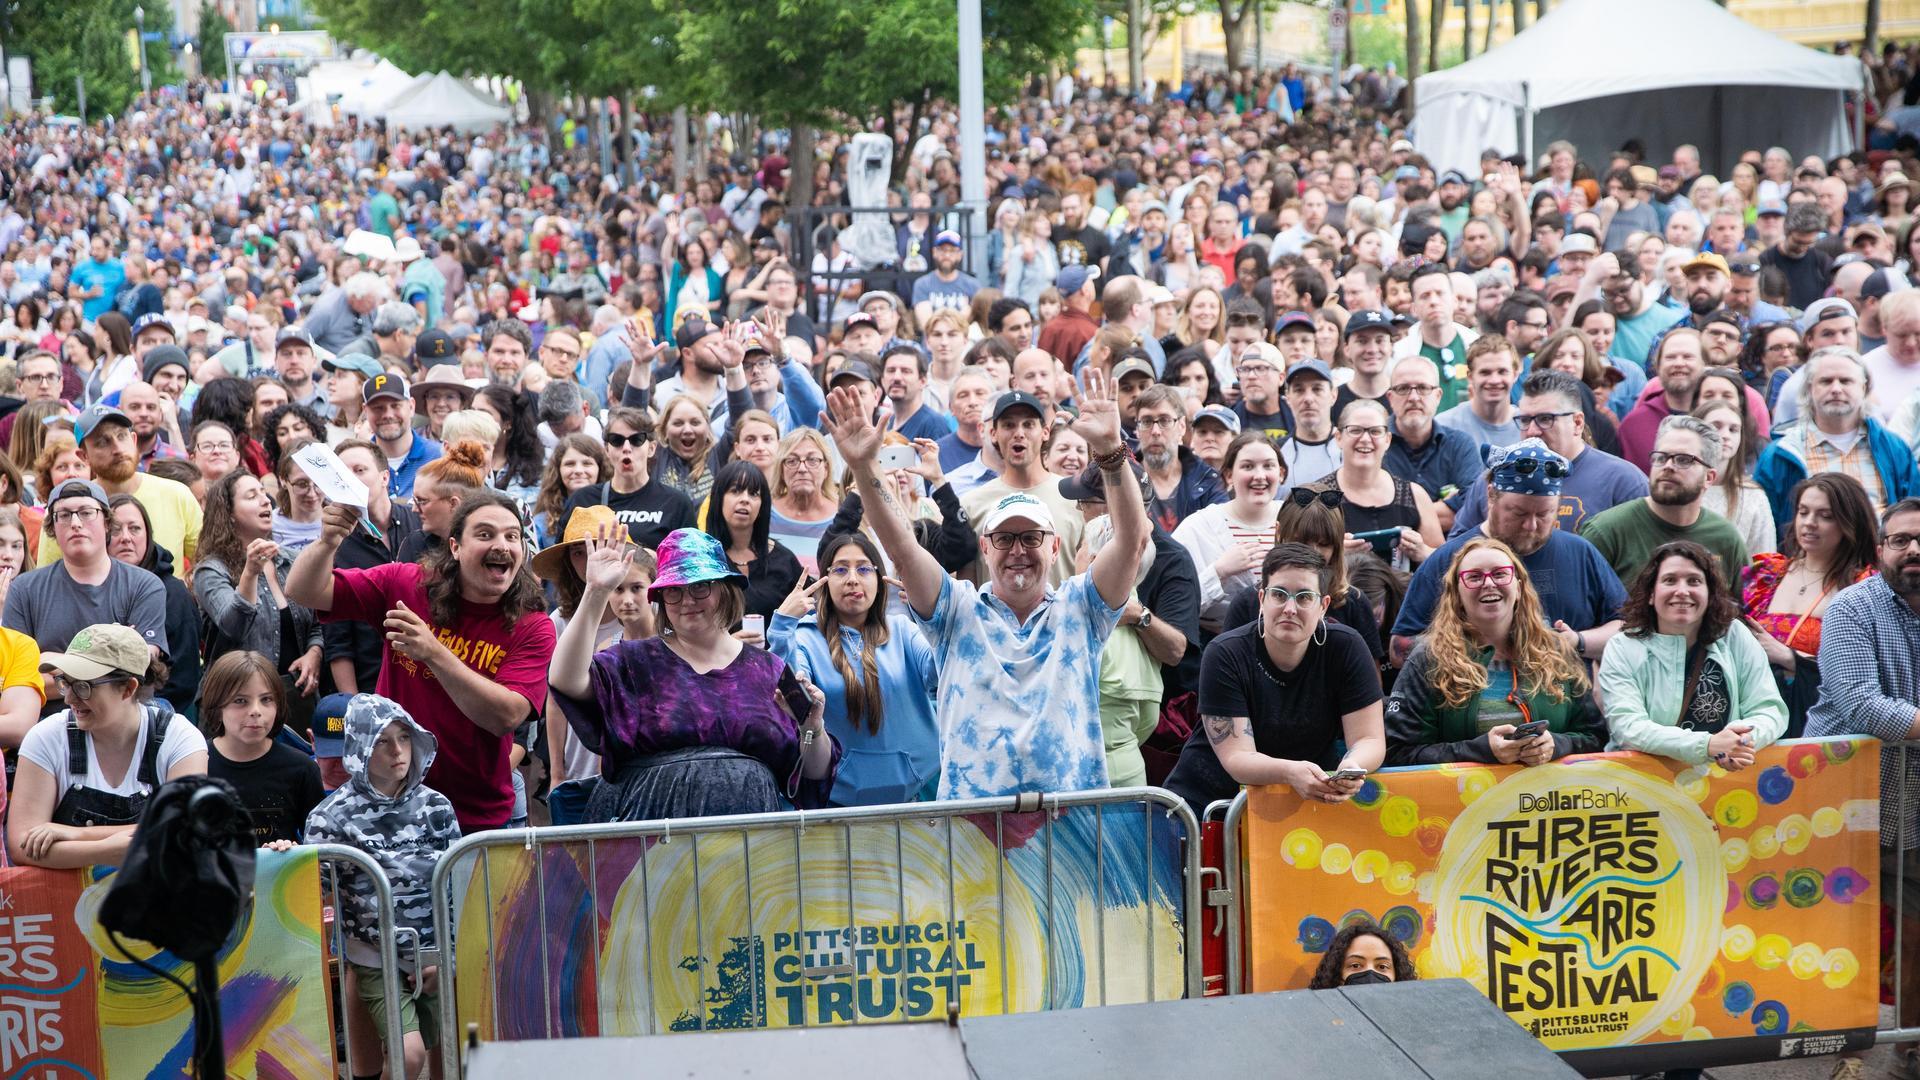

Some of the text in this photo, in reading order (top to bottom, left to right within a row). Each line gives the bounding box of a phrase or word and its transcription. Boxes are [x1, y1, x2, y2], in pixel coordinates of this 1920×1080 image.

[375, 375, 387, 391] P
[470, 639, 507, 675] FIVE
[1388, 700, 1401, 713] 26
[1487, 811, 1660, 864] THREE
[1560, 886, 1657, 958] ARTS
[774, 920, 966, 952] PITTSBURGH
[773, 943, 986, 983] CULTURAL
[775, 974, 972, 1026] TRUST
[1542, 1011, 1629, 1028] PITTSBURGH
[1542, 1023, 1629, 1037] CULTURAL TRUST
[1803, 1039, 1848, 1049] CULTURAL
[1803, 1045, 1845, 1055] TRUST
